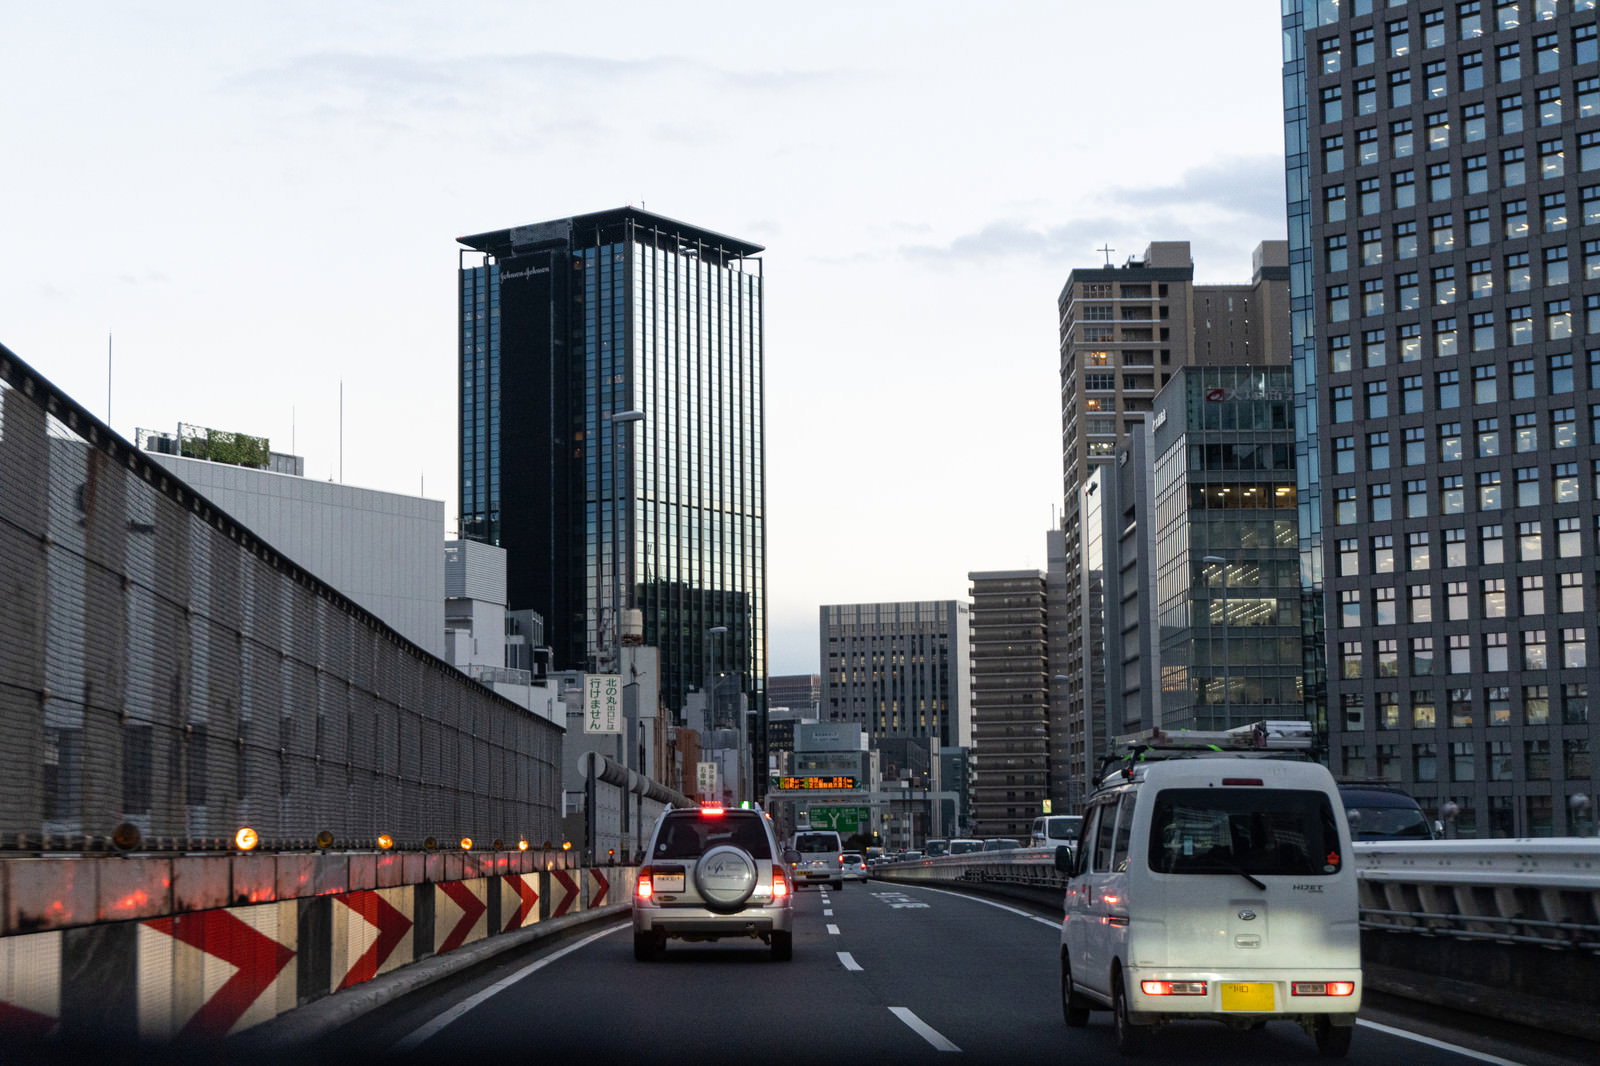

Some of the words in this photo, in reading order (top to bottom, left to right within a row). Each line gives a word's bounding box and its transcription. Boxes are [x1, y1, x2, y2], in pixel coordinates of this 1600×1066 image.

[590, 678, 601, 730] 行けません
[605, 678, 617, 730] 北の丸出口には
